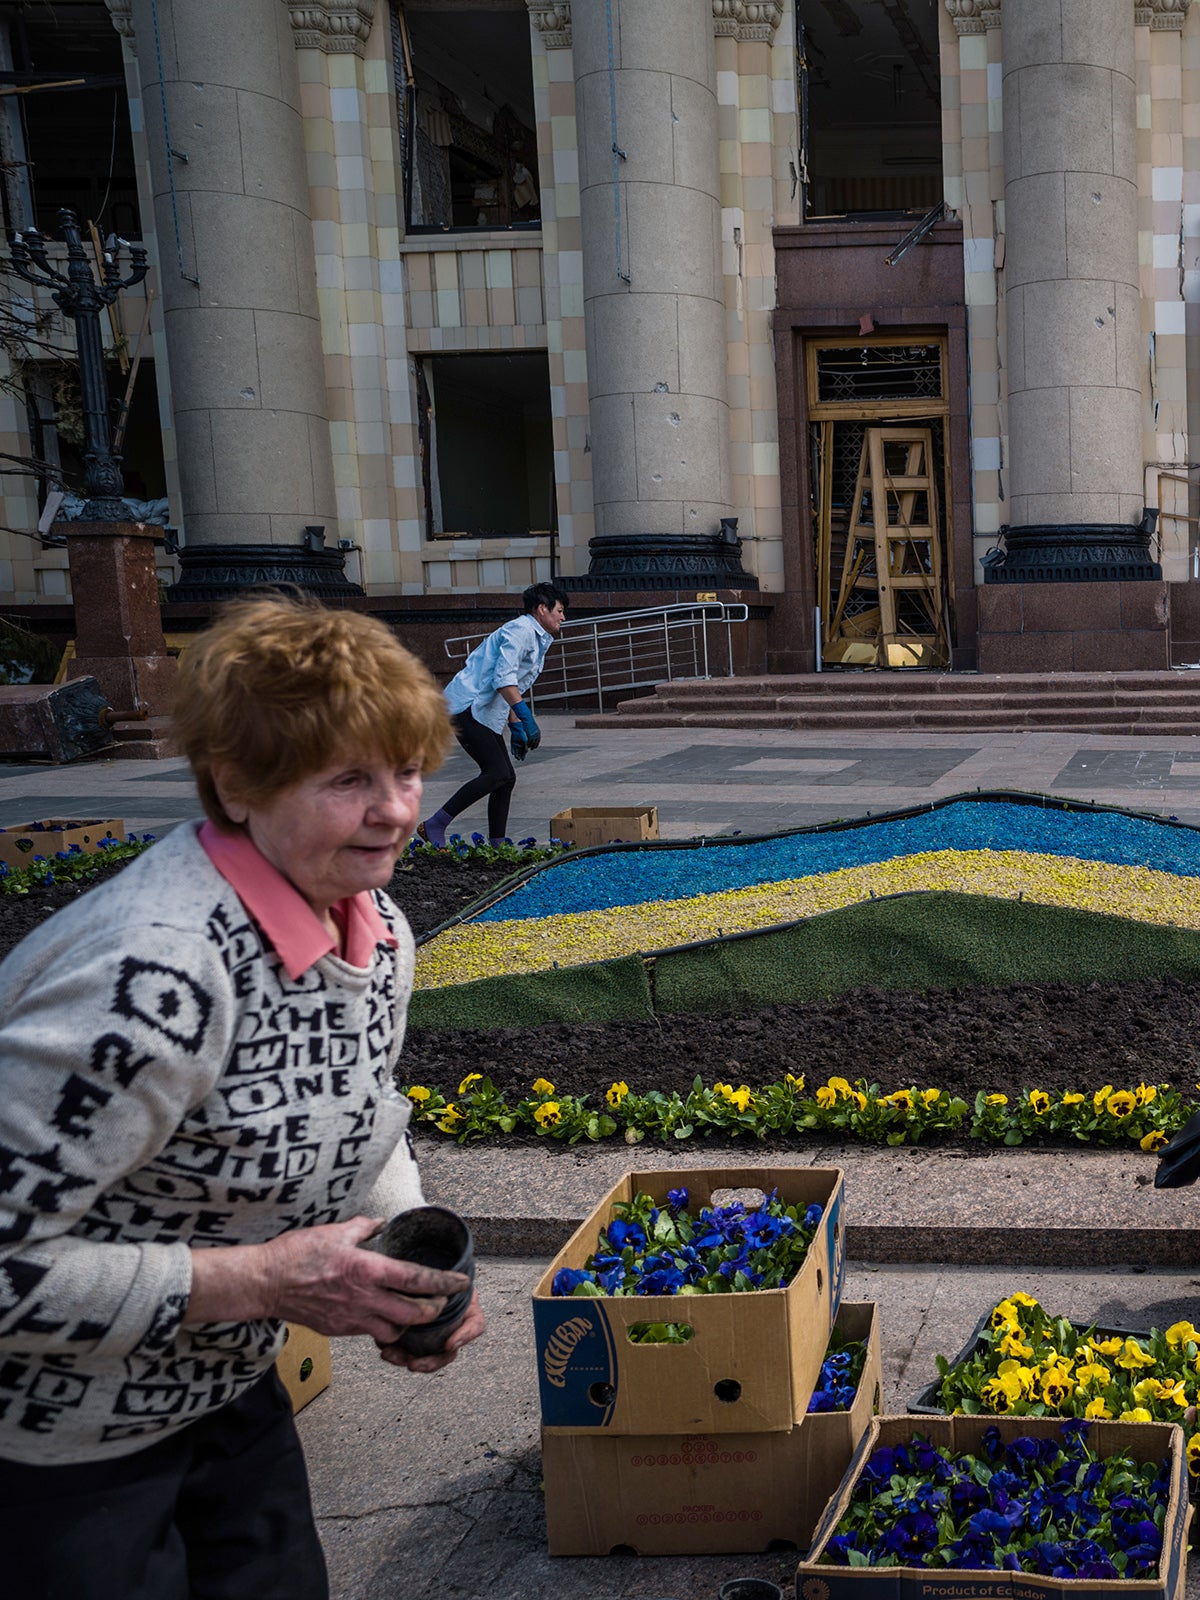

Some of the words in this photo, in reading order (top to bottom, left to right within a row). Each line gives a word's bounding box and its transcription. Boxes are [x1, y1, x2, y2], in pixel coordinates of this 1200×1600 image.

[216, 1069, 351, 1117] ONE
[922, 1585, 976, 1596] Product
[979, 1585, 993, 1596] of
[996, 1586, 1046, 1600] Ecador
